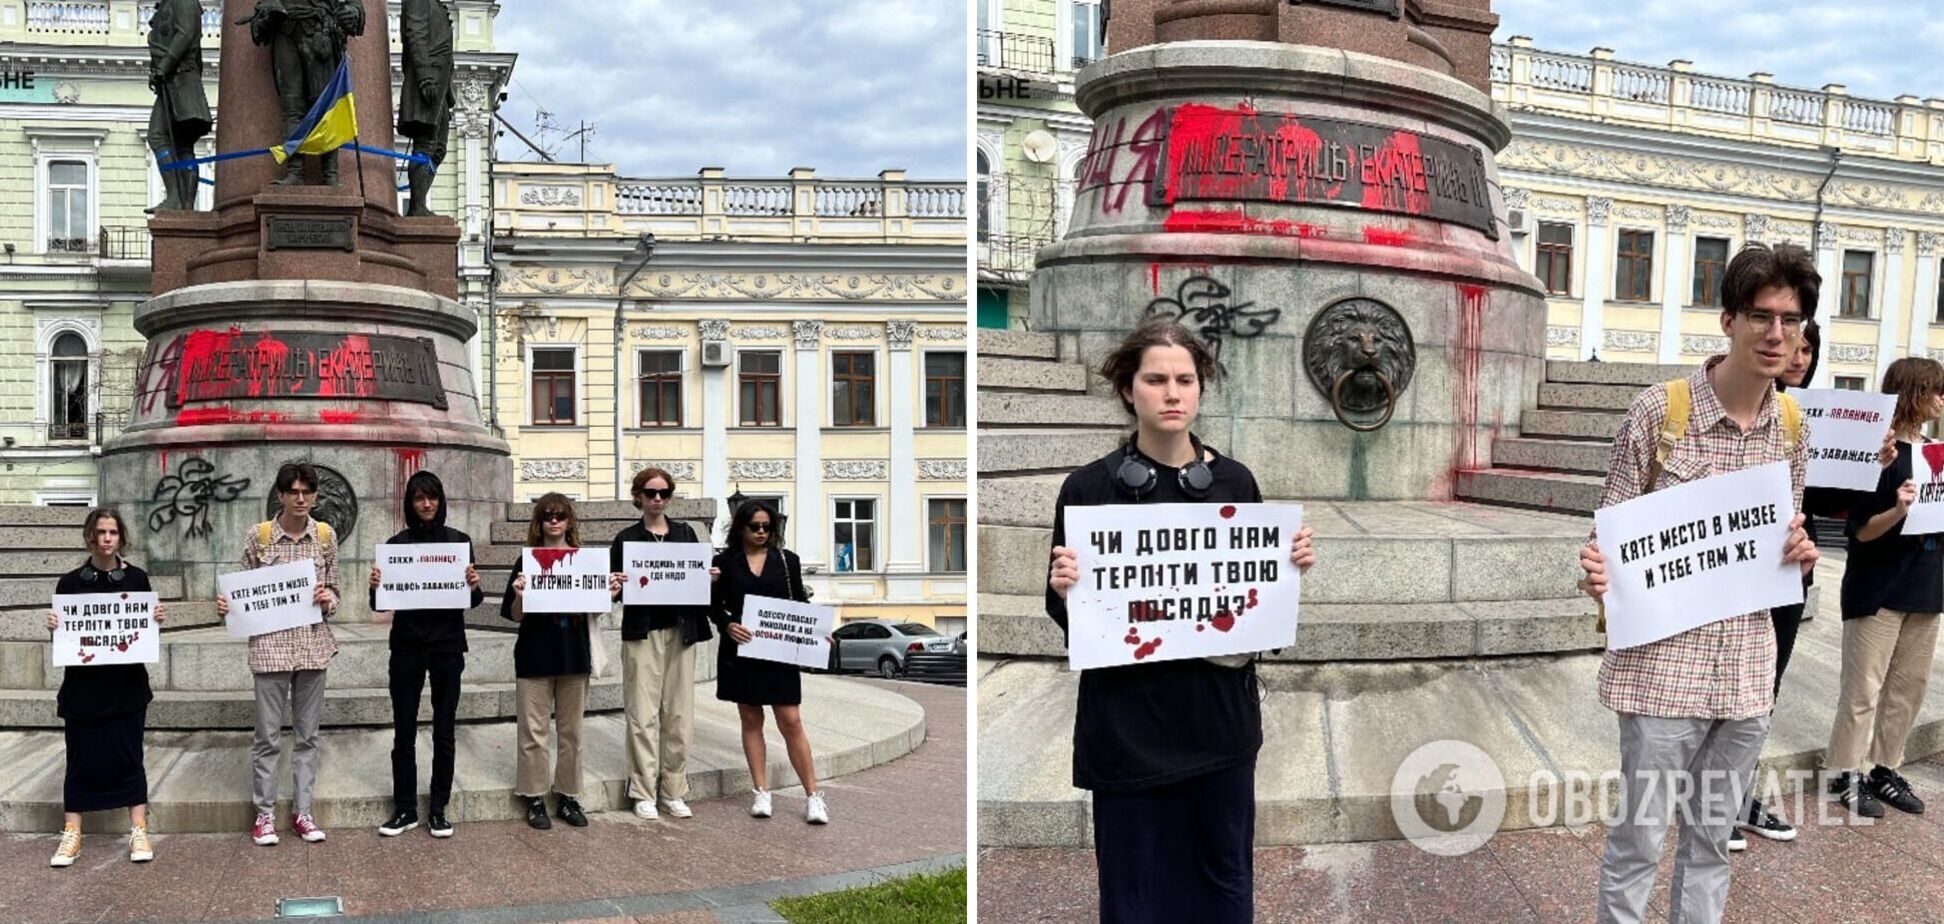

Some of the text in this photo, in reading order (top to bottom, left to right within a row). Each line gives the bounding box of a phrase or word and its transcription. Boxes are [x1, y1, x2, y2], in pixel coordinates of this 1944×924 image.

[1090, 526, 1280, 556] ЧИ ДОВГО НАМ
[1620, 503, 1777, 564] КАТЕ МЕСТО В МУЗЕЕ
[632, 560, 643, 568] ТЫ
[644, 560, 676, 569] СИДИШЬ
[677, 560, 686, 569] НЕ
[1644, 539, 1757, 590] И ТЕБЕ ТАМ ЖЕ
[531, 574, 573, 590] КАТЕРИНА
[582, 574, 607, 590] ПУТІН
[650, 572, 686, 581] ГДЕ НАДО
[1092, 559, 1278, 590] ТЕРПІТИ ТВОЮ
[230, 588, 250, 600] КАТЕ
[252, 583, 277, 596] МЕСТО
[286, 577, 309, 589] МУЗЕЕ
[382, 583, 394, 591] ЧИ
[395, 582, 421, 592] ЩОСЬ
[63, 602, 148, 617] ЧИ ДОВГО НАМ
[252, 599, 269, 611] ТЕБЕ
[271, 596, 288, 607] ТАМ
[289, 593, 300, 604] ЖЕ
[1128, 594, 1246, 624] ПОСАДУ?
[64, 618, 148, 631] ТЕРПІТИ ТВОЮ
[757, 609, 818, 625] ОДЕССУ СПАСАЕТ
[804, 627, 814, 635] НЕ
[80, 634, 133, 647] ПОСАДУ?
